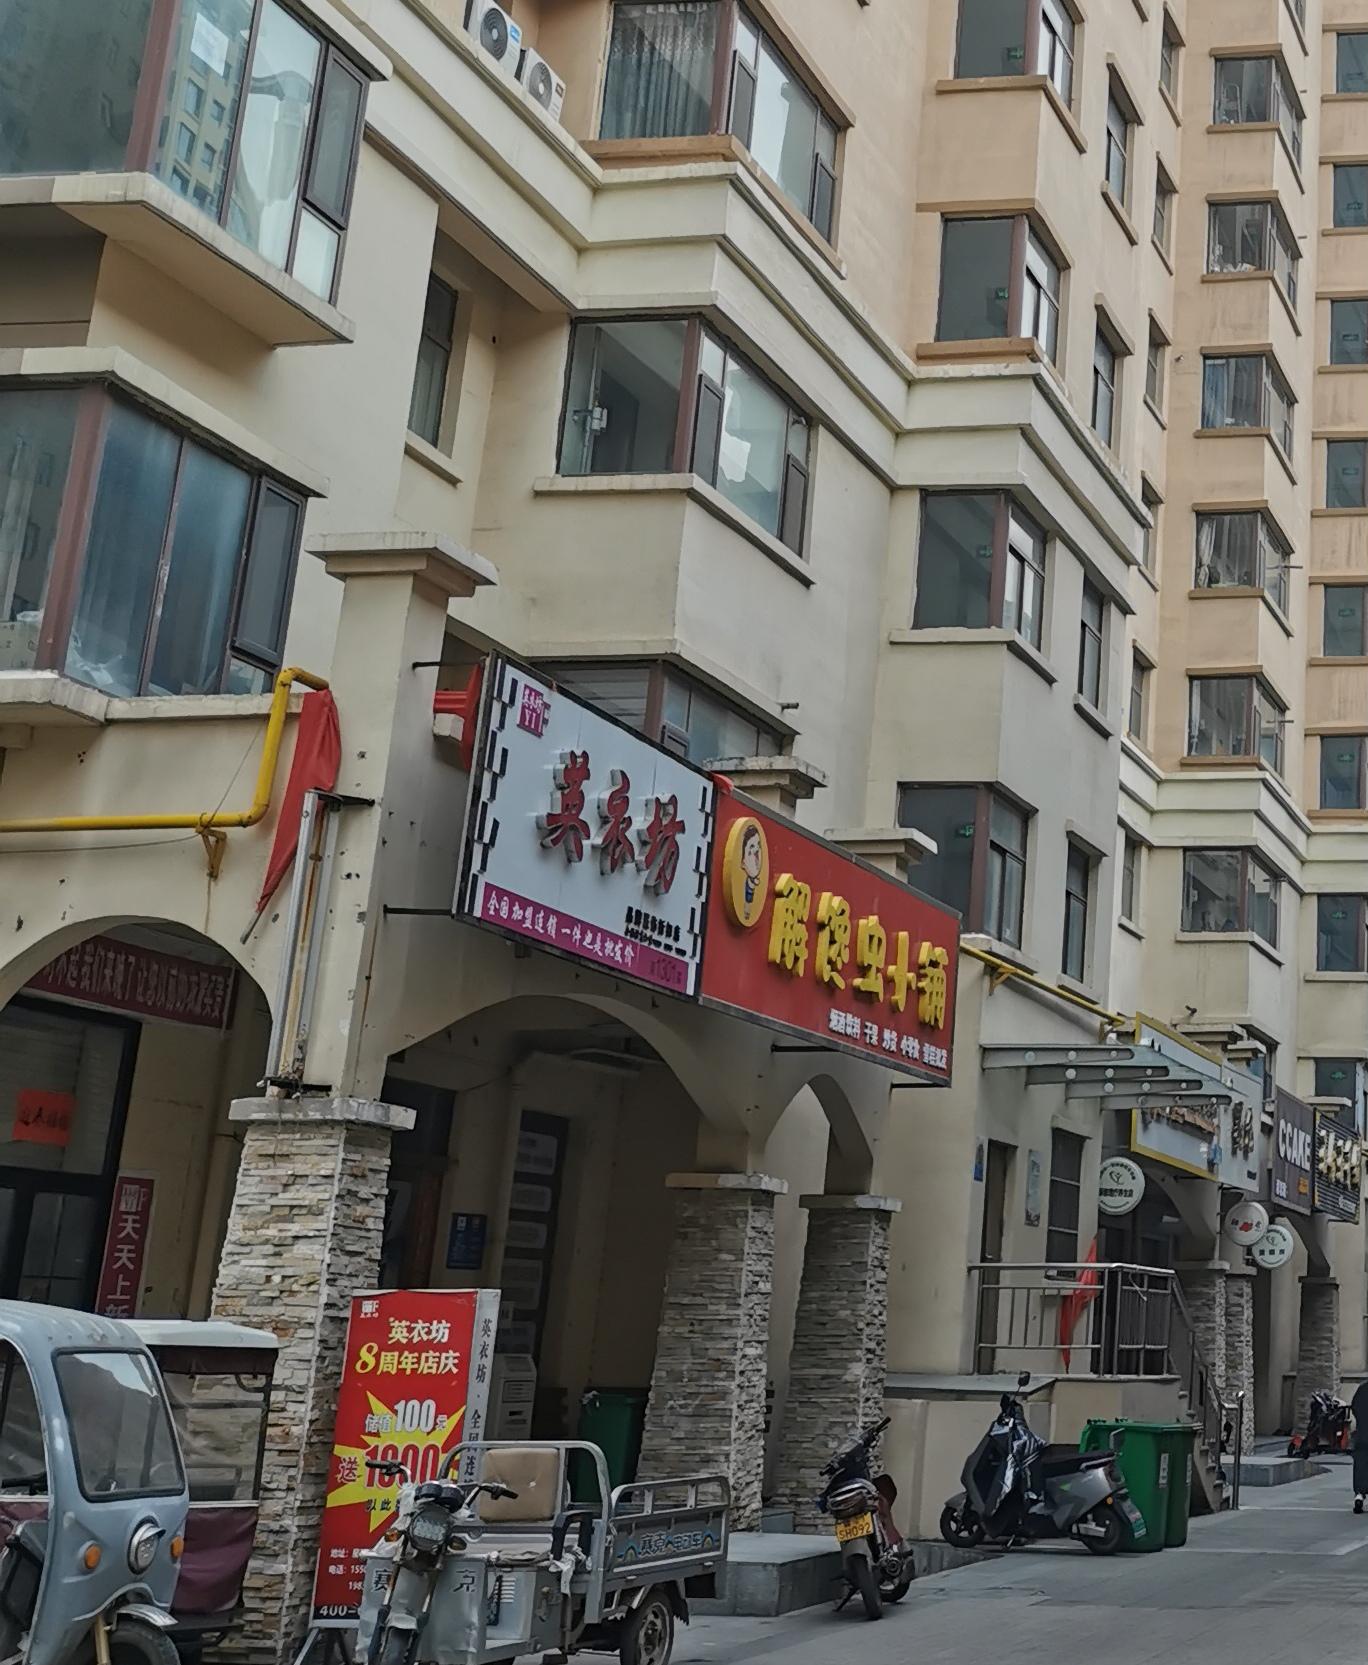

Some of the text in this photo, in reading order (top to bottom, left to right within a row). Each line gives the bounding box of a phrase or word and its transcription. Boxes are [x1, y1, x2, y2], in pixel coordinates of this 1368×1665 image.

[768, 873, 949, 1029] 解馋虫小铺
[388, 1319, 451, 1344] 英衣坊
[355, 1342, 460, 1375] 8周年店庆
[337, 1457, 360, 1483] 送
